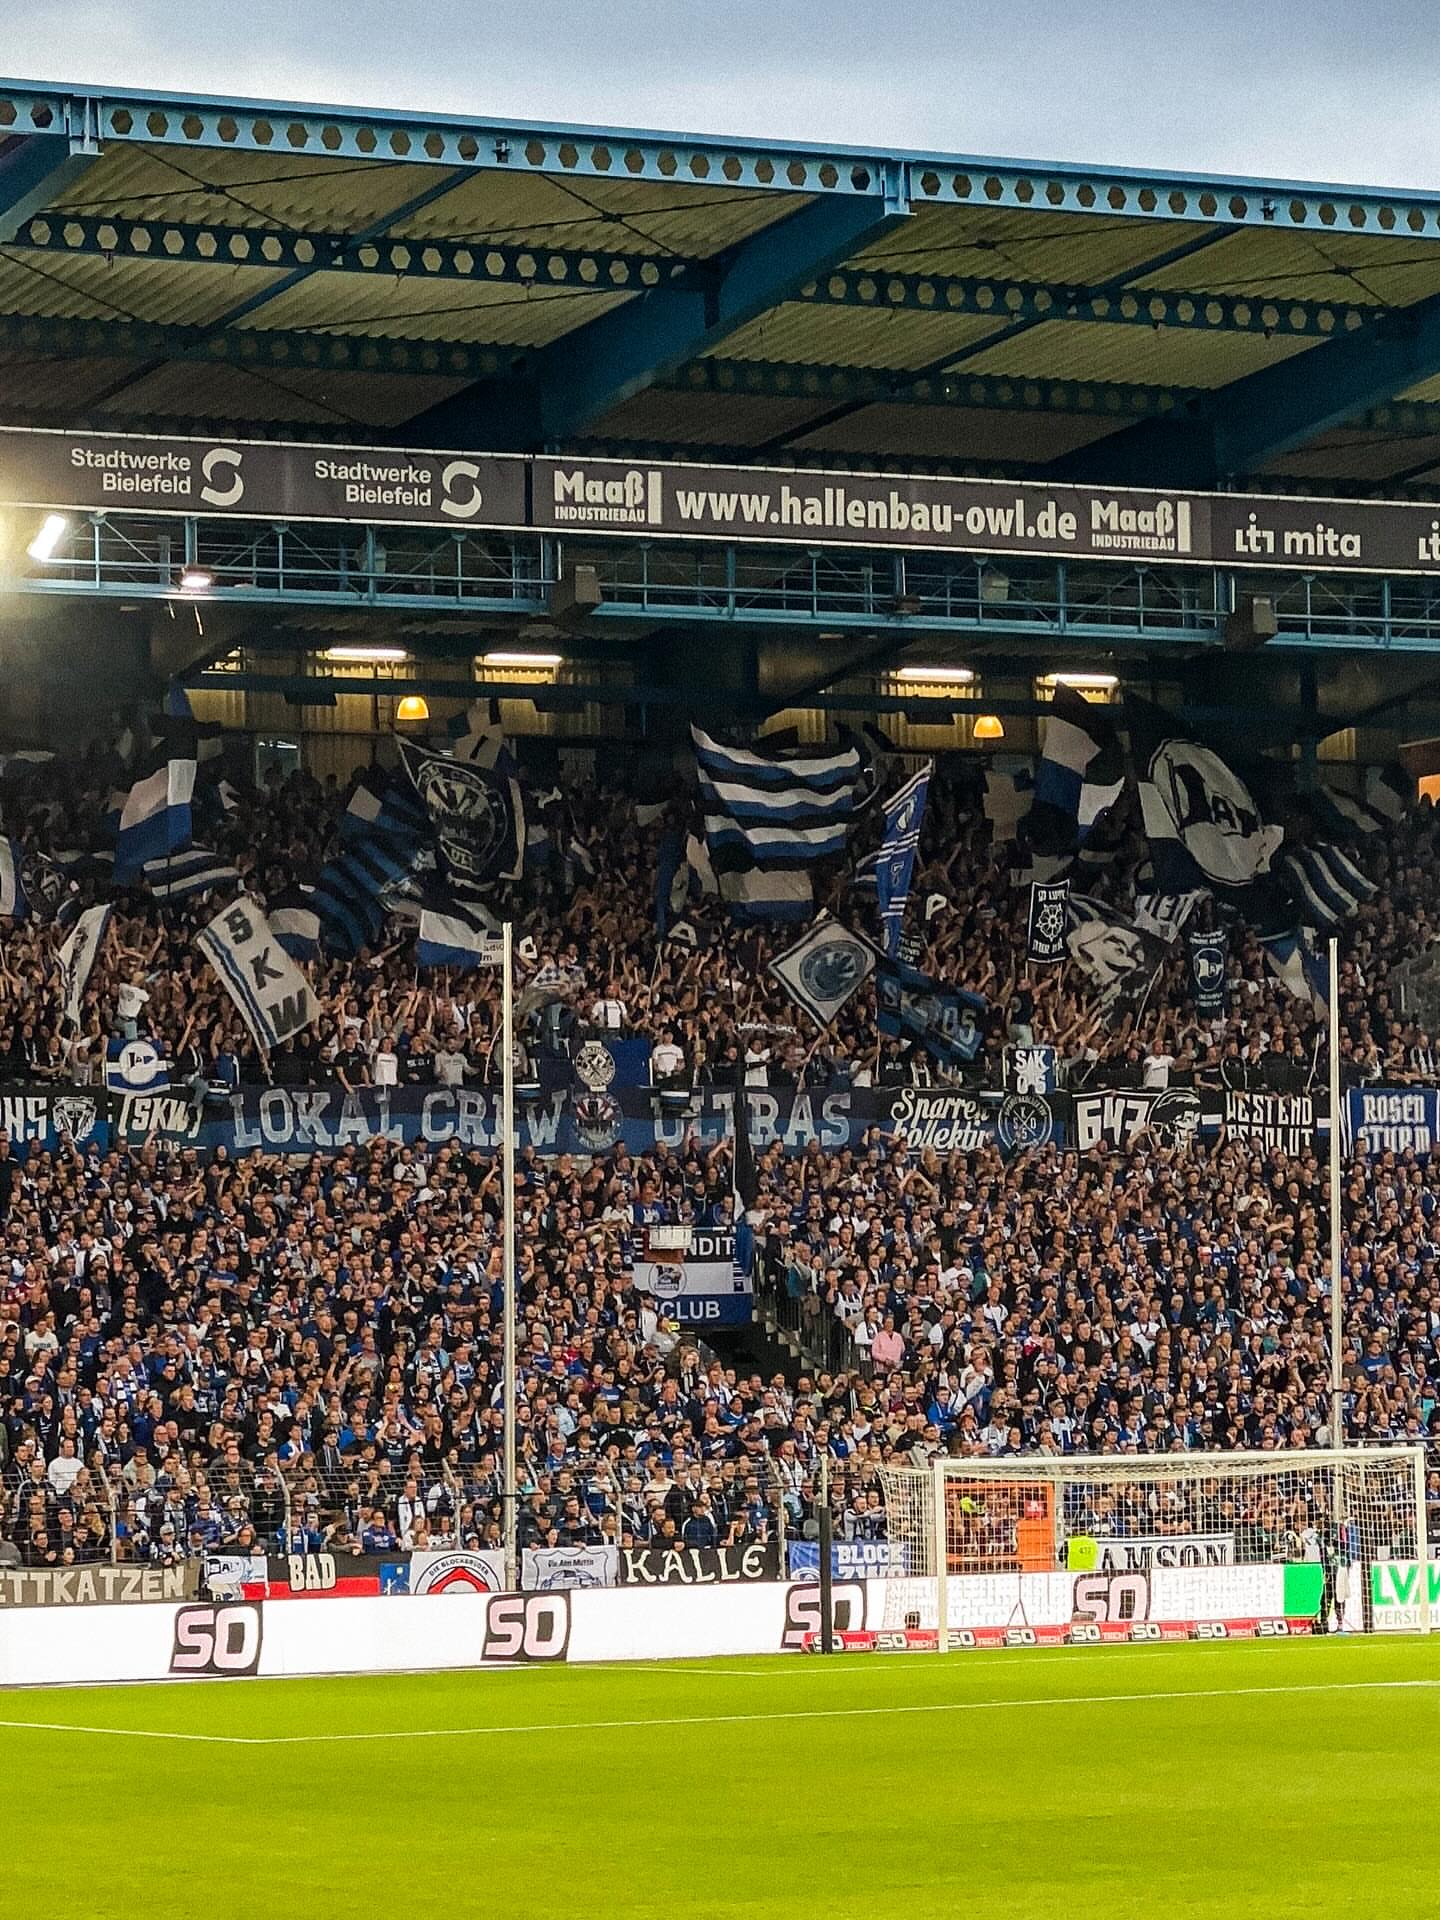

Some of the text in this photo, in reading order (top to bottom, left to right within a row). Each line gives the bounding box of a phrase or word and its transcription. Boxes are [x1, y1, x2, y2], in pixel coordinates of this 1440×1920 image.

[71, 448, 191, 471] Stadtwerke
[102, 472, 191, 495] Bielefeld
[314, 460, 432, 484] Stadtwerke
[345, 484, 432, 507] Bielefeld
[554, 470, 644, 508] Maaß
[554, 507, 646, 523] INDUSTRIEBAU
[676, 485, 1077, 541] www.hallenbau-owl.de
[1091, 499, 1174, 536] Maaß
[1091, 533, 1176, 551] INDUSTRIEBAU
[1284, 522, 1361, 558] mita
[230, 1087, 404, 1149] LOKAL
[422, 1088, 568, 1148] CREW
[651, 1091, 852, 1148] ULTRAS
[655, 1300, 721, 1320] CLUB
[623, 1545, 767, 1584] KALLE
[836, 1543, 905, 1564] BLOCK
[287, 1552, 337, 1592] BAD
[1075, 1574, 1148, 1622] SO
[785, 1584, 864, 1643] SO
[485, 1594, 568, 1657] SO
[1006, 1628, 1036, 1644] SO
[1071, 1624, 1101, 1641] SO
[1132, 1624, 1161, 1640] SO
[1197, 1622, 1228, 1638] SO
[1258, 1620, 1289, 1635] SO
[173, 1606, 259, 1669] SO
[876, 1634, 908, 1649] SO
